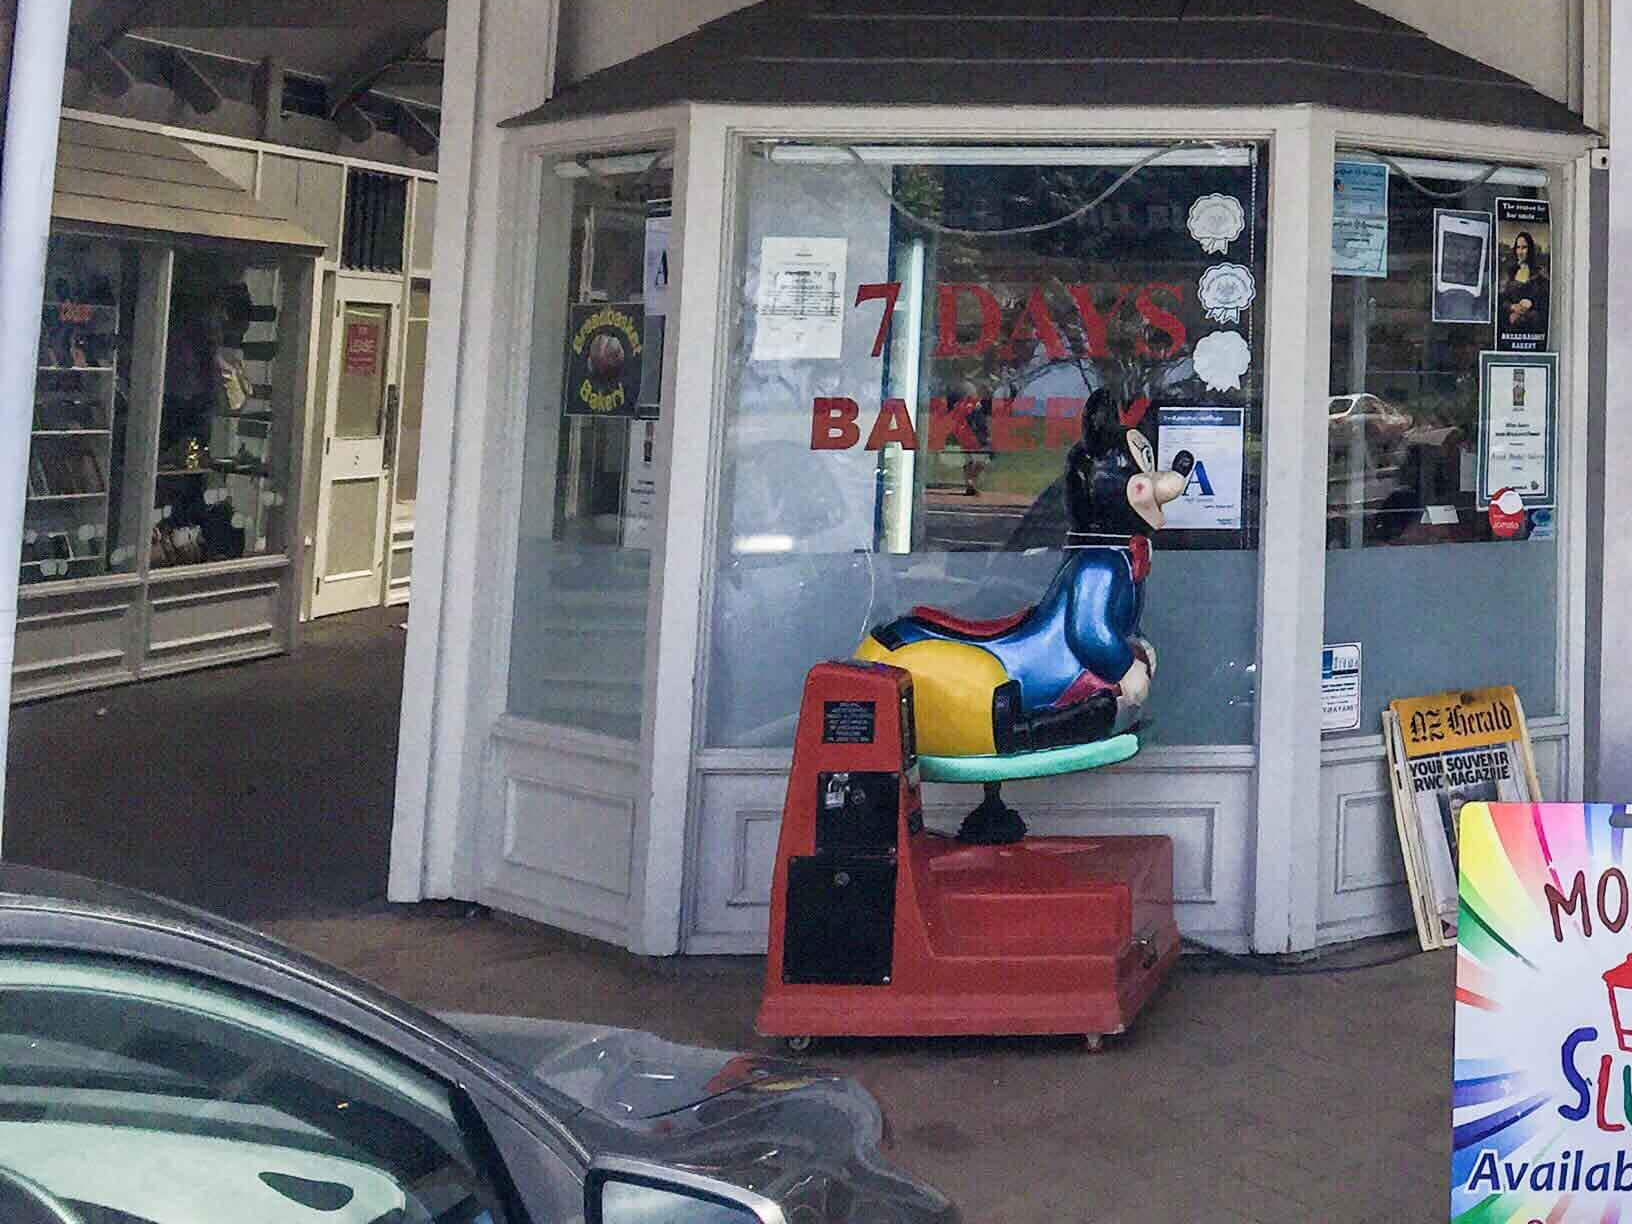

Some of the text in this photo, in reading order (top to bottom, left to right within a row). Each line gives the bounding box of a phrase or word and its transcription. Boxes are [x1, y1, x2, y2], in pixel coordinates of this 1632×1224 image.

[855, 282, 901, 357] 7
[929, 282, 1187, 360] DAYS
[1183, 460, 1215, 496] A
[1411, 700, 1513, 742] NZ Herald
[1408, 751, 1510, 778] YOUR SOUVENIR
